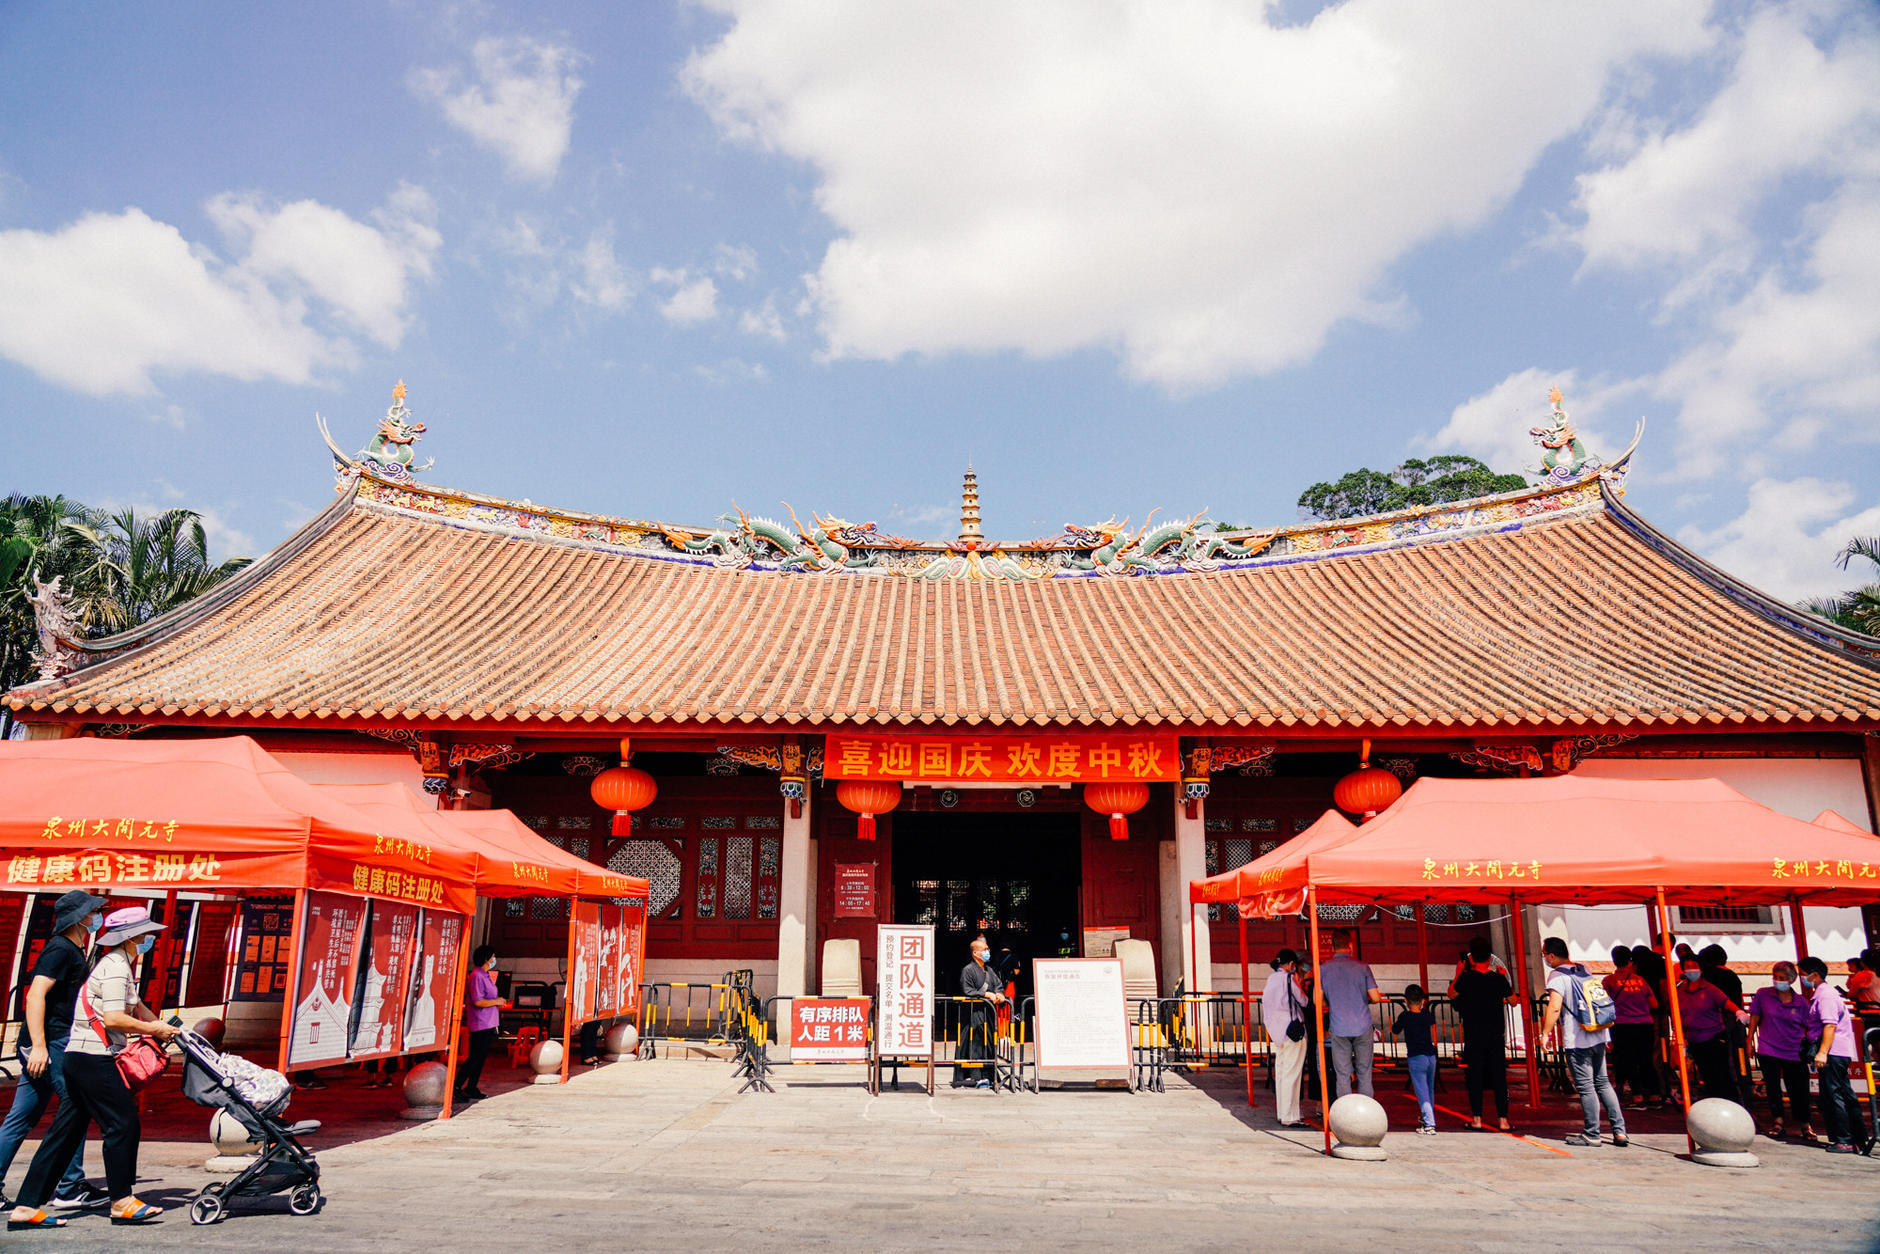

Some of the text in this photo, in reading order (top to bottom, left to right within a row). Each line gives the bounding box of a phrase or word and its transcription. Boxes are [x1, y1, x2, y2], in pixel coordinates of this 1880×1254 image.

[838, 740, 1164, 778] 喜迎国庆 欢度中秋
[7, 854, 222, 883] 健康码注册处
[352, 864, 444, 904] 健康码注册处
[898, 936, 925, 1048] 团队通道
[799, 1006, 864, 1023] 有序排队
